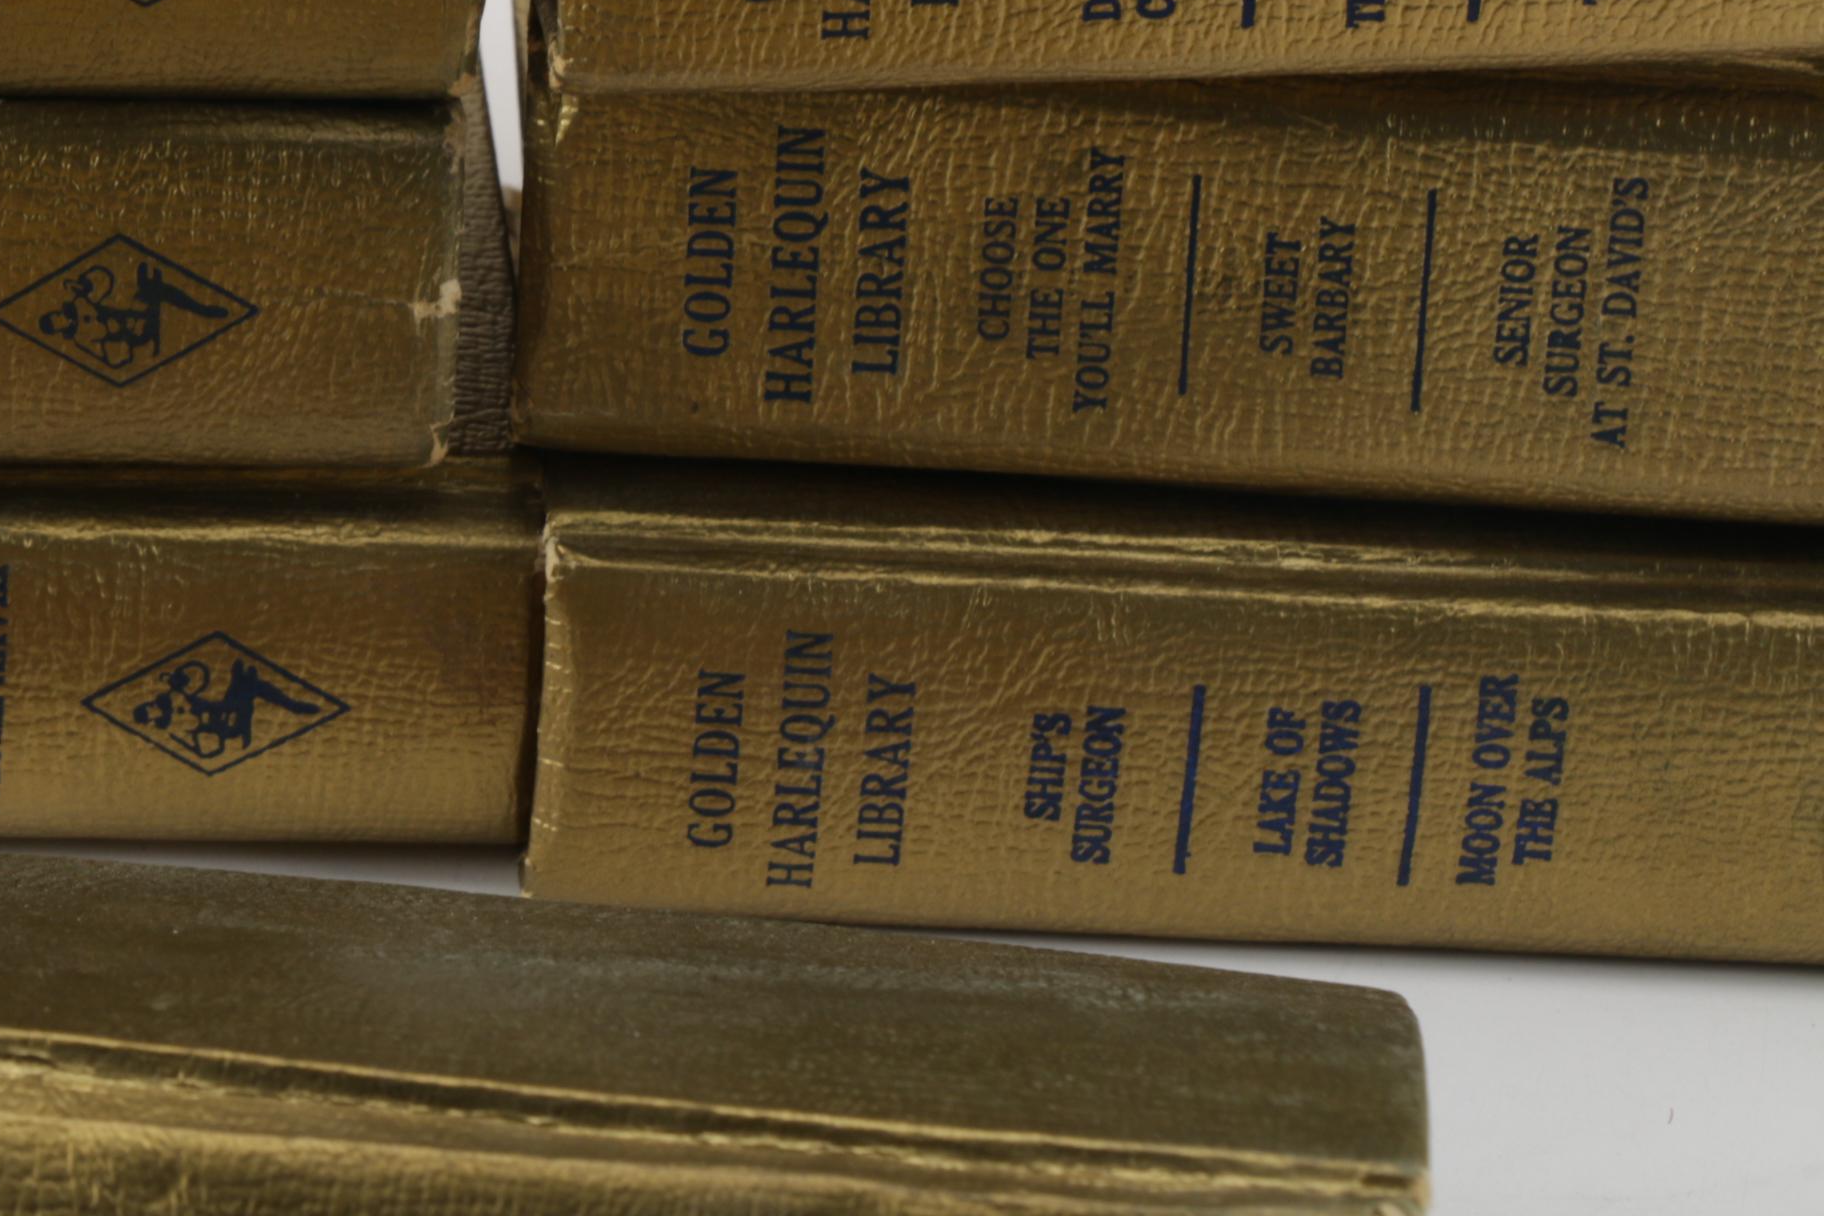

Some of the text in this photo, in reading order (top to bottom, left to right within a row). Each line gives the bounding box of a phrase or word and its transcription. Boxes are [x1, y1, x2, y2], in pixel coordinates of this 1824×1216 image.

[682, 169, 737, 356] GOLDEN
[765, 127, 830, 403] HARLEQUIN
[852, 169, 910, 375] LIBRARY
[976, 196, 1020, 342] CHOOSE
[1026, 197, 1072, 359] THE ONE
[1072, 148, 1127, 412] YOU'LL MARRY
[1260, 231, 1305, 356] SWEET
[1311, 218, 1356, 377] BARBARY
[1493, 236, 1541, 367] SENIOR
[1541, 226, 1590, 394] SURGEON
[1591, 177, 1649, 448] AT ST. DAVID'S
[688, 671, 745, 848] GOLDEN
[768, 631, 836, 888] HARLEQUIN
[855, 673, 917, 864] LIBRARY
[1025, 714, 1072, 820] SHIP'S
[1073, 707, 1126, 864] SURGEON
[1255, 708, 1306, 854] LAKE OF
[1307, 701, 1361, 867] SHADOWS
[1457, 675, 1520, 884] MOON OVER
[1514, 699, 1569, 864] THE ALPS
